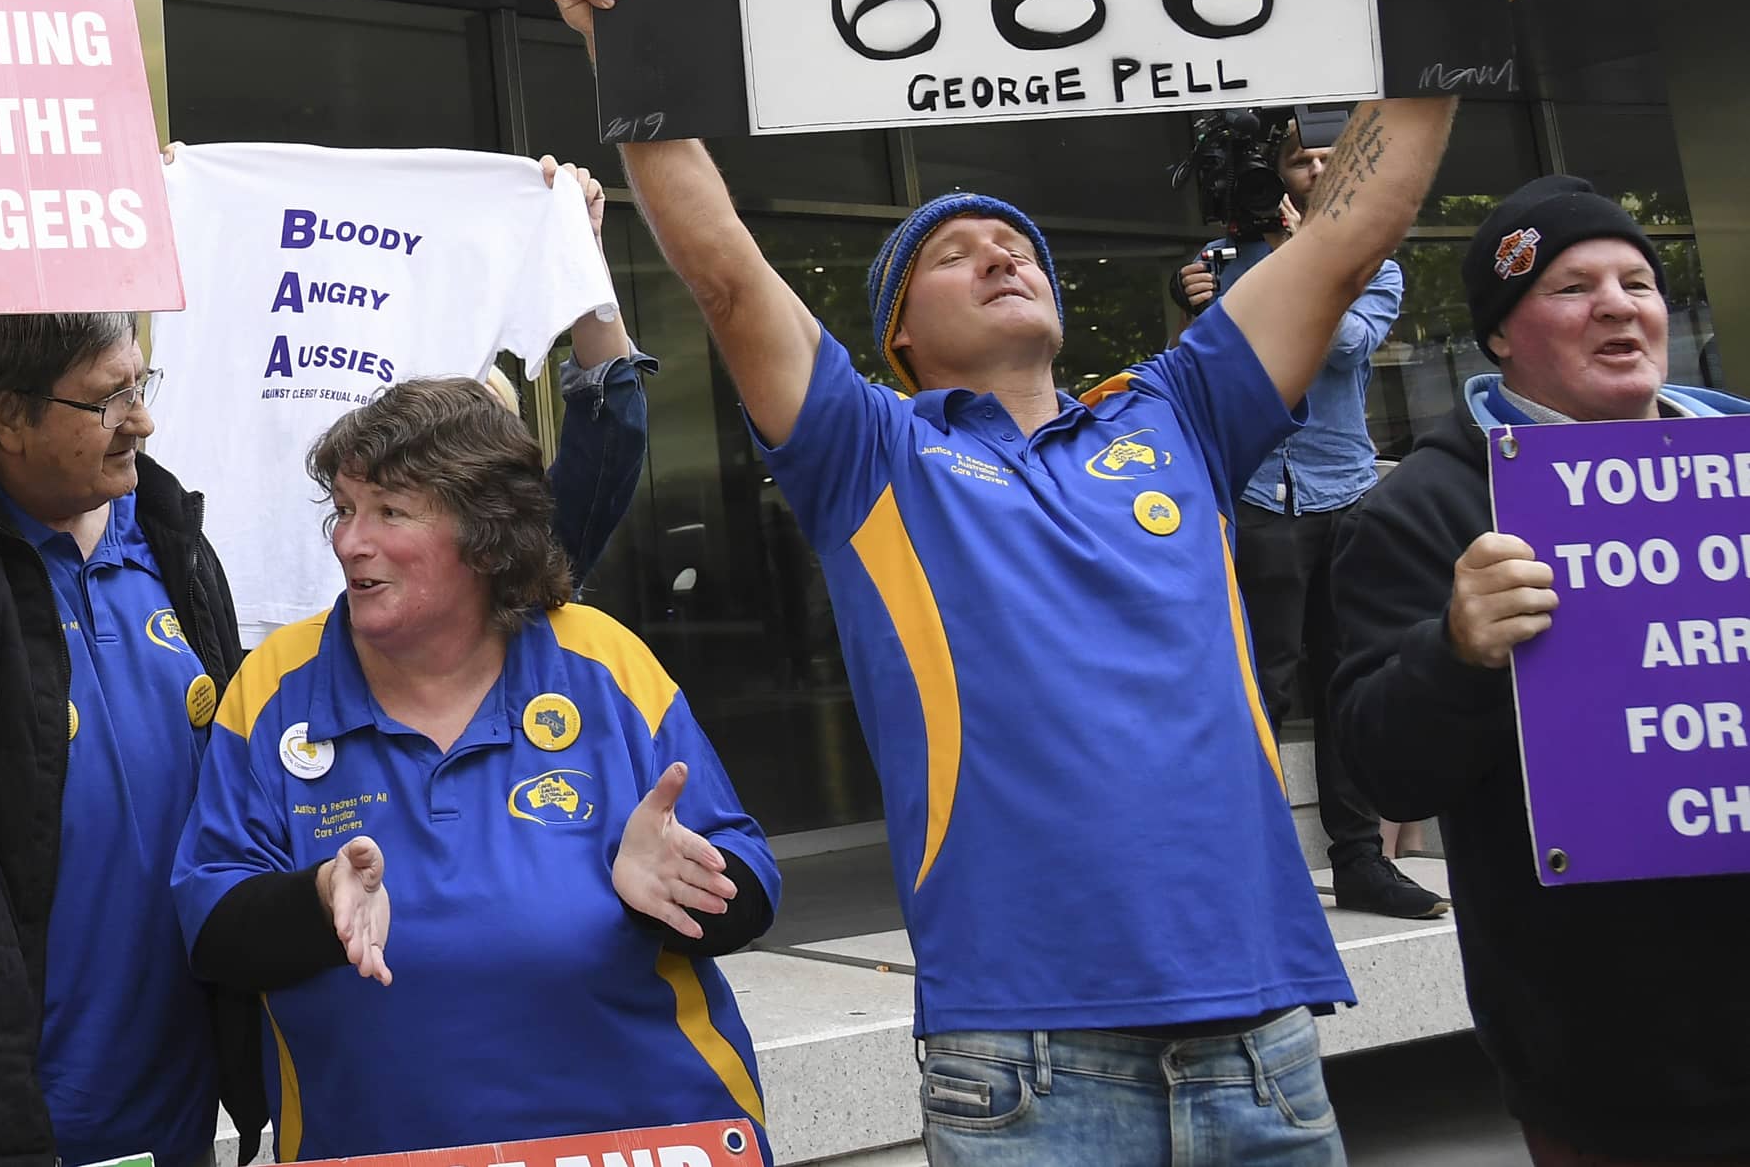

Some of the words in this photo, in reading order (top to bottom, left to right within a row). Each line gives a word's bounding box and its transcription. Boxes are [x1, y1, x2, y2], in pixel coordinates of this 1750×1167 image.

[907, 68, 1085, 112] GEORGE
[1113, 57, 1248, 103] PELL
[280, 209, 423, 255] BLOODY
[271, 271, 390, 313] ANGRY
[264, 335, 395, 383] AUSSIES
[319, 389, 351, 402] SEXUAL
[1555, 538, 1680, 589] TOO
[1697, 535, 1750, 581] O
[1641, 617, 1750, 668] ARR
[1625, 702, 1748, 754] FOR
[1667, 786, 1750, 837] CH
